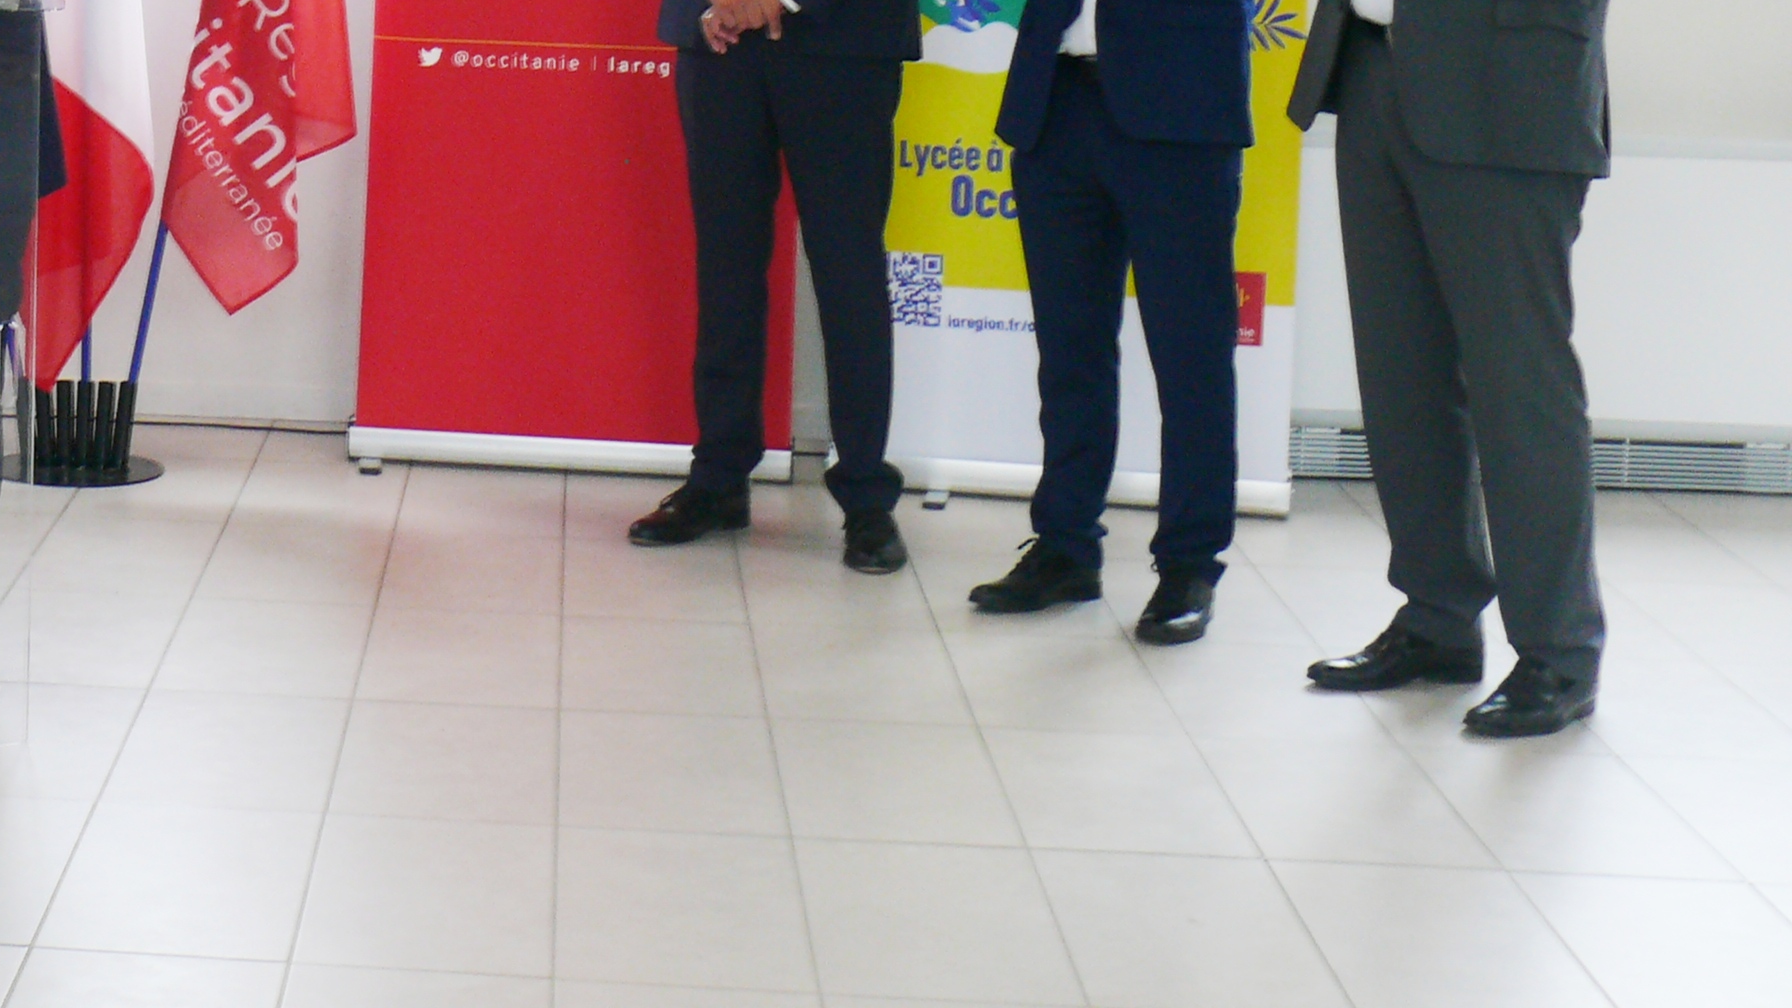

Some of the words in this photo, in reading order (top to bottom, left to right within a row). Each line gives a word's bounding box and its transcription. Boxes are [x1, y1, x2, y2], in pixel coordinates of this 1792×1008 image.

[452, 50, 580, 72] @occitanie
[608, 56, 671, 78] lareg
[180, 100, 284, 251] éditerranée
[900, 137, 981, 177] Lycée
[987, 139, 1004, 173] à
